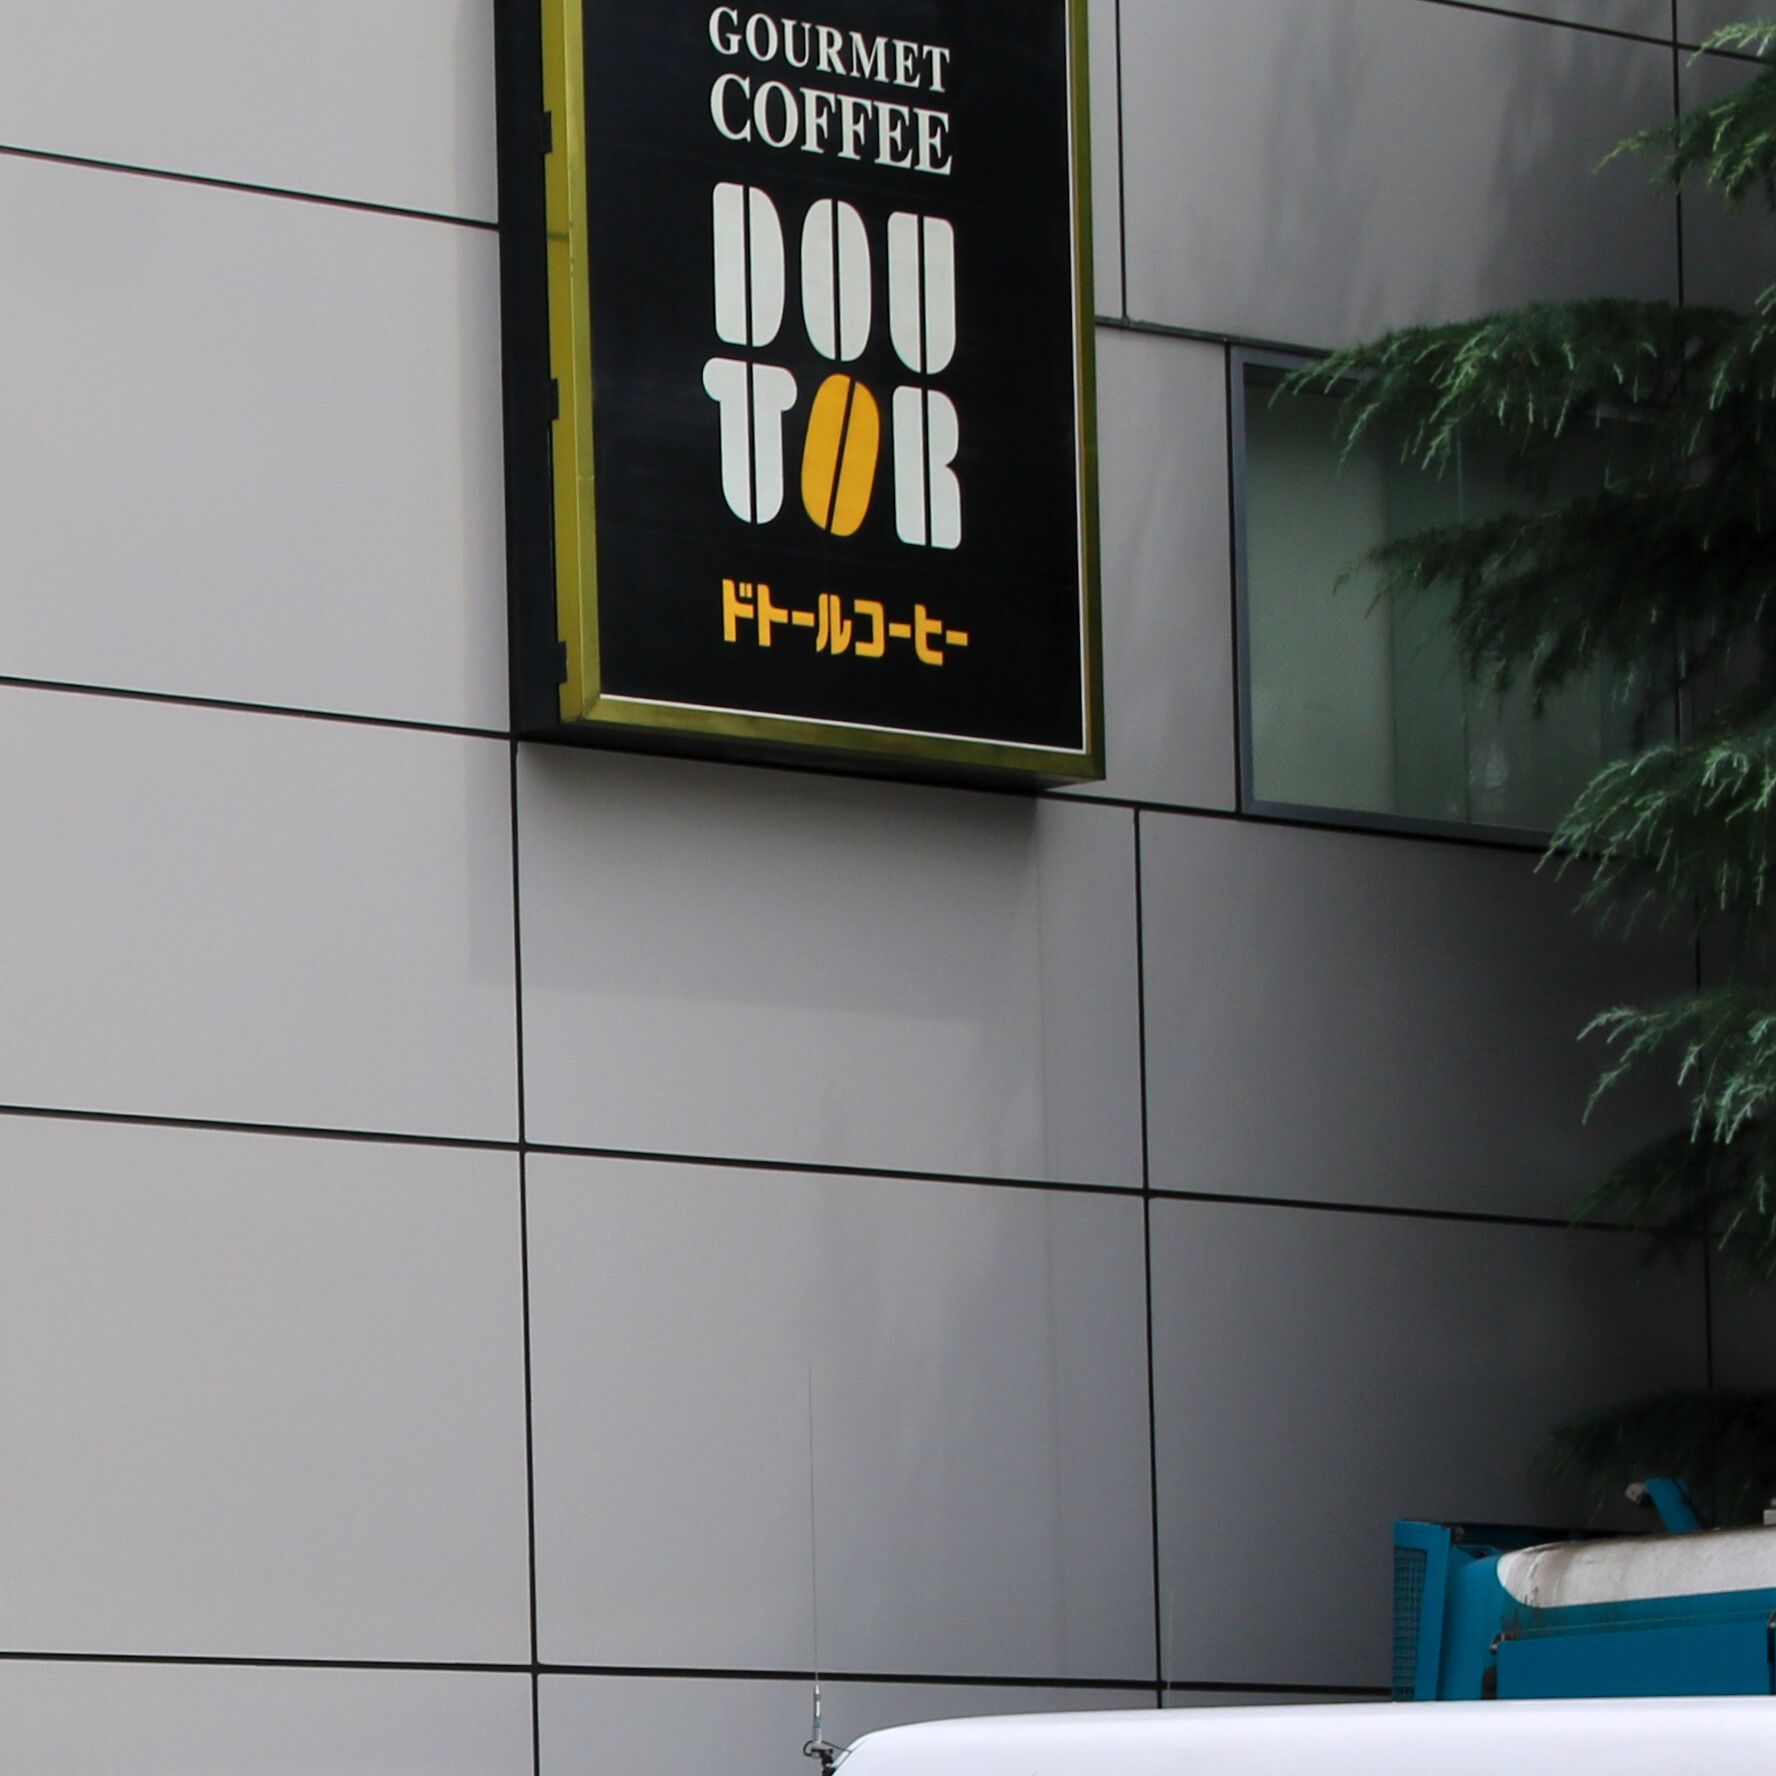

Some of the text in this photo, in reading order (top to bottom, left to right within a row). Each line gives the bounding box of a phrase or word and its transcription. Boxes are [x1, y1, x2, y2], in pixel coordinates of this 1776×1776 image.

[707, 6, 950, 94] GOURMET
[709, 73, 953, 176] COFFEE
[721, 578, 969, 667] ドトールコーヒー
